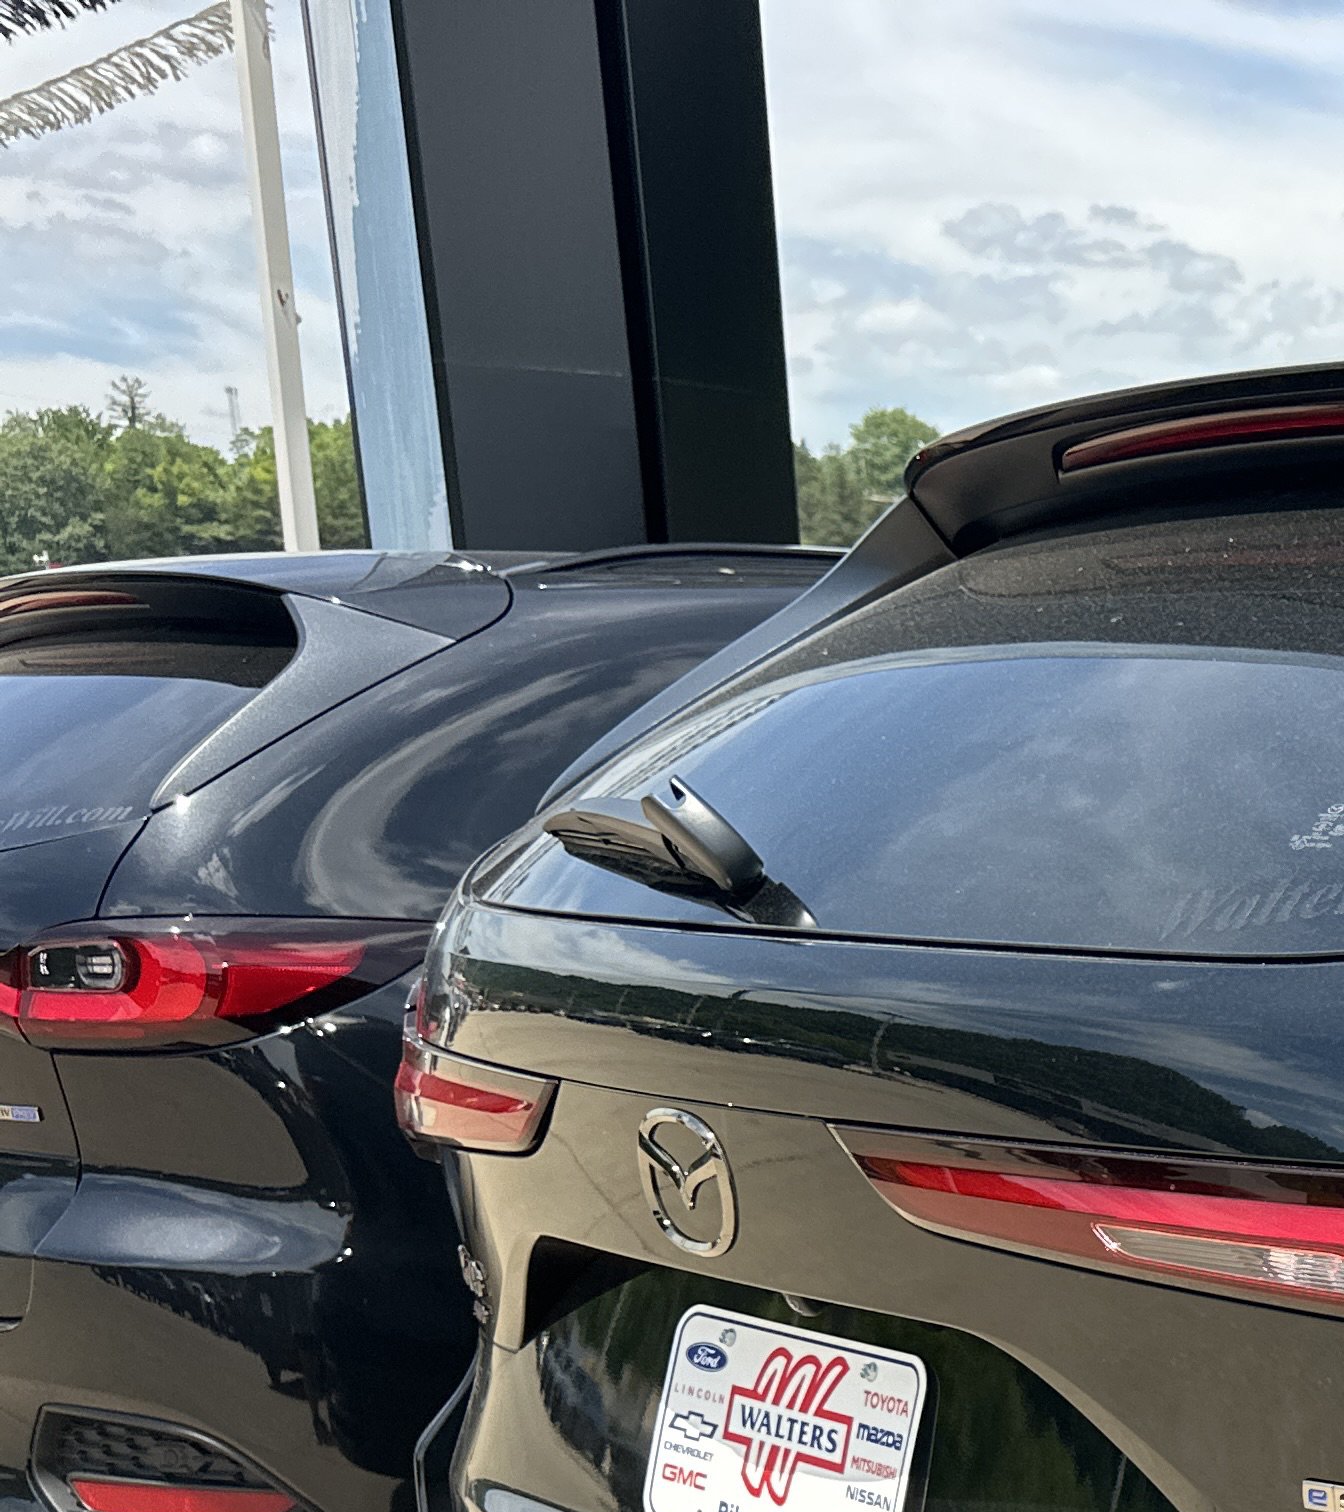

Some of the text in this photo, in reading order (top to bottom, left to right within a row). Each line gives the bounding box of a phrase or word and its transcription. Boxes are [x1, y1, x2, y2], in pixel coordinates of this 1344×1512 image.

[0, 804, 134, 832] Will.com
[693, 1346, 721, 1368] Ford
[674, 1382, 725, 1404] LINCOLN
[864, 1390, 909, 1417] TOYOTA
[740, 1404, 838, 1453] WALTERS
[664, 1441, 714, 1461] CHEVROLET
[662, 1463, 707, 1490] GMC
[850, 1455, 897, 1480] MITSUBISHI
[846, 1484, 891, 1511] NISSAN
